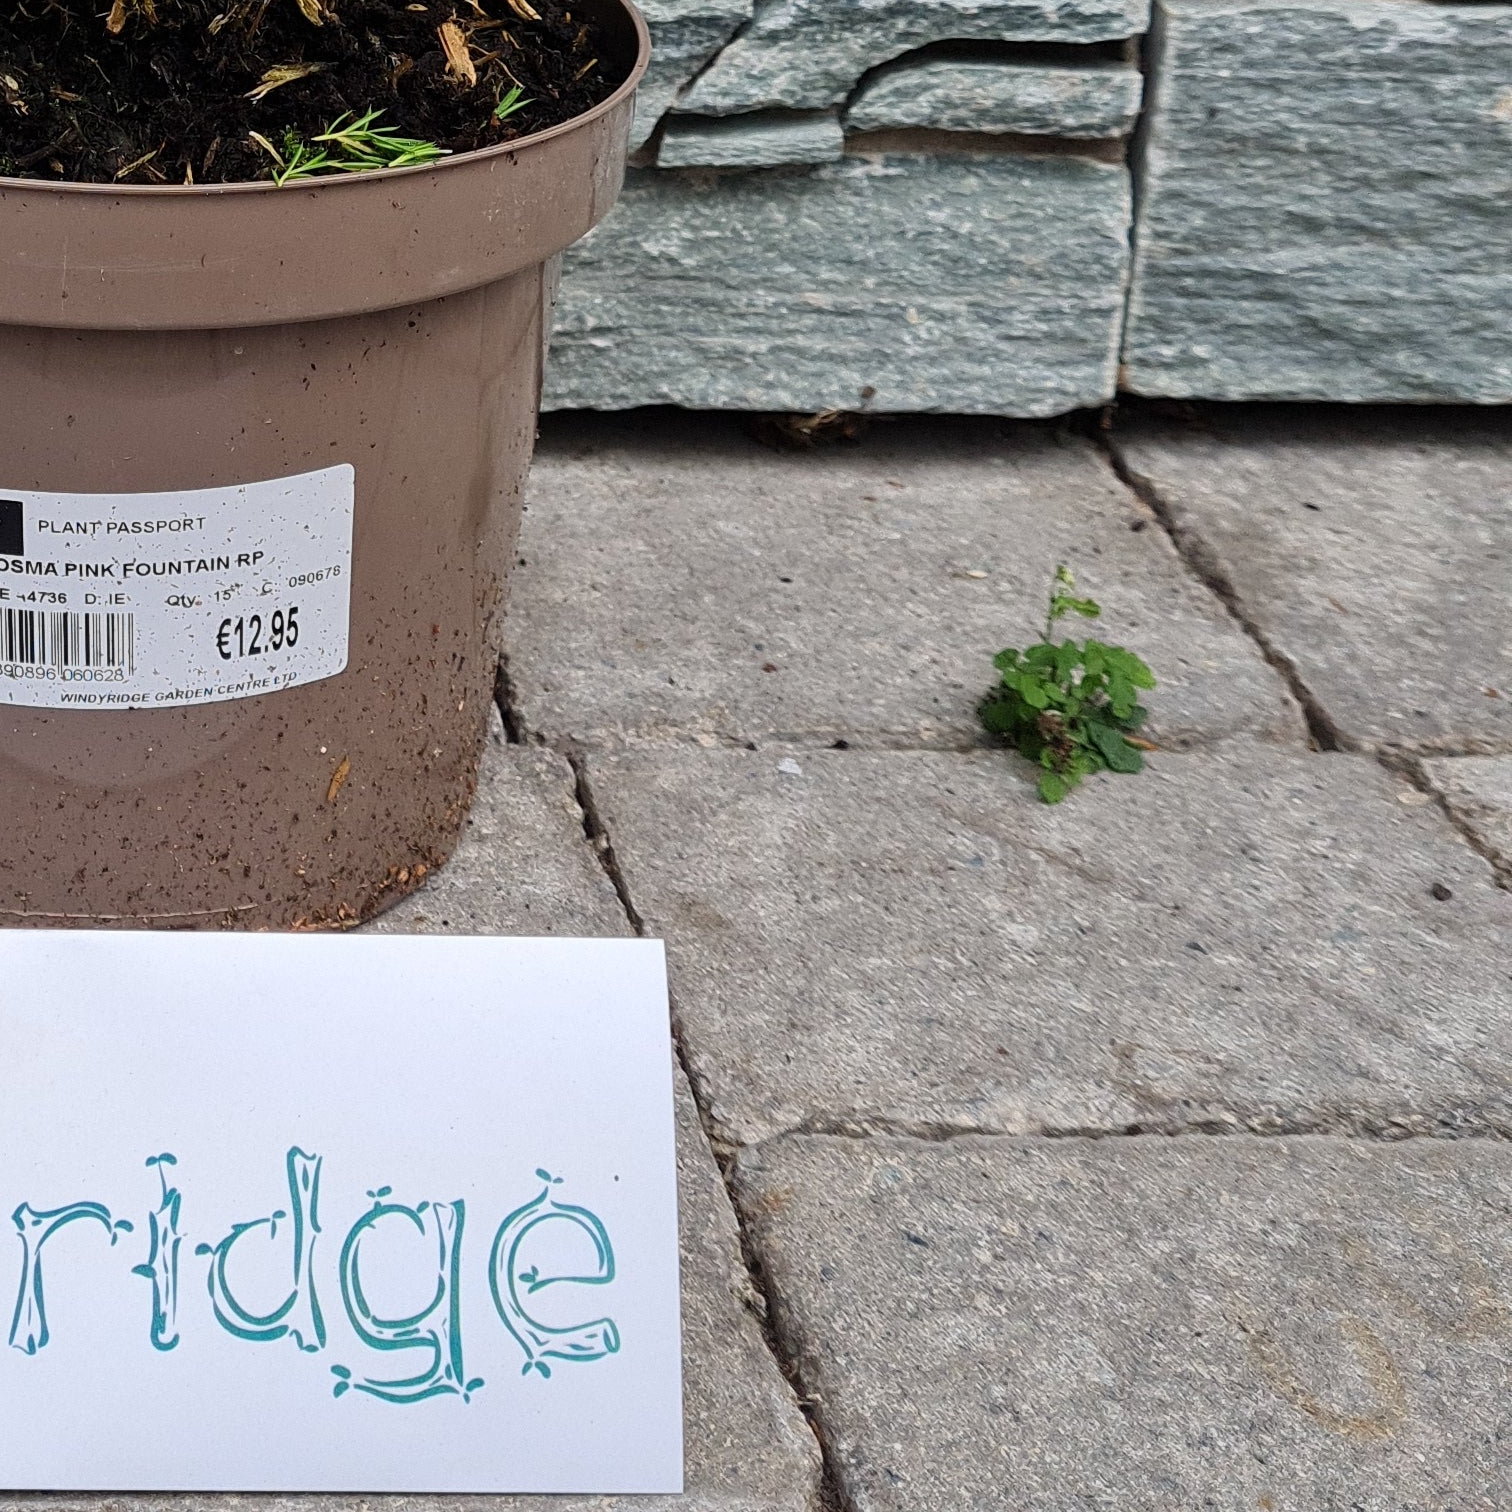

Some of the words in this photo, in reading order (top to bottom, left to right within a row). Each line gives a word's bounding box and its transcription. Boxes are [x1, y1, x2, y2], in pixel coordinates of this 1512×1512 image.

[38, 519, 101, 536] PLANT
[106, 516, 206, 536] PASSPORT
[65, 562, 115, 578] PINK
[122, 555, 230, 578] FOUNTAIN
[237, 550, 265, 568] RP
[84, 592, 101, 605] D:
[108, 592, 126, 605] IE
[214, 588, 232, 603] 15
[216, 606, 299, 661] €12.95
[62, 667, 125, 682] 060628
[60, 691, 151, 705] WINDYRIDGE
[155, 687, 214, 702] GARDEN
[216, 676, 271, 696] CENTRE
[273, 670, 298, 686] LTD
